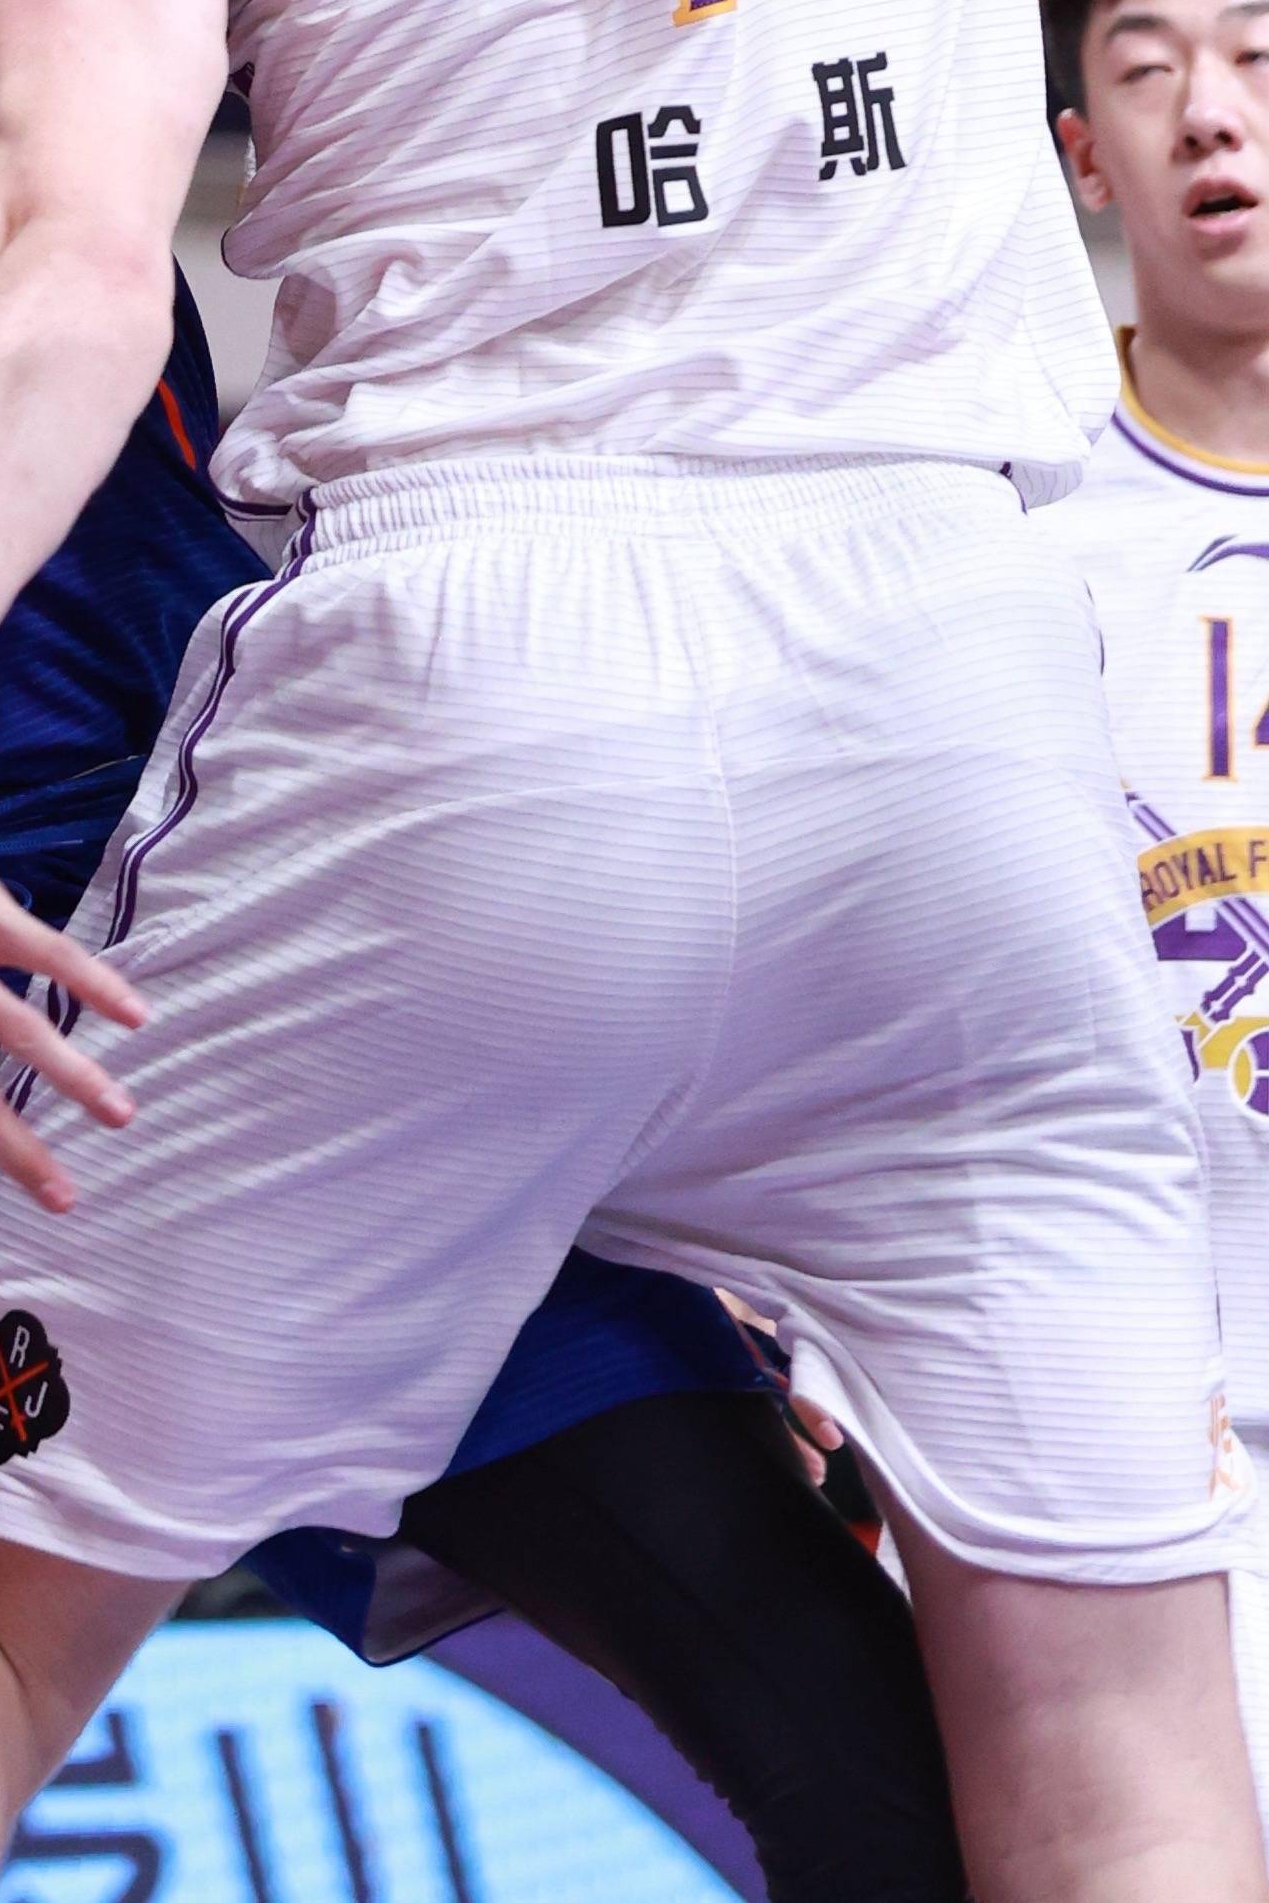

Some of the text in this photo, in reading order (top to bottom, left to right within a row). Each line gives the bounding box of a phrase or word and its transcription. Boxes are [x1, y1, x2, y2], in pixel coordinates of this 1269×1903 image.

[595, 52, 908, 230] 哈斯
[1196, 612, 1269, 784] 1
[1140, 841, 1238, 913] ROYAL
